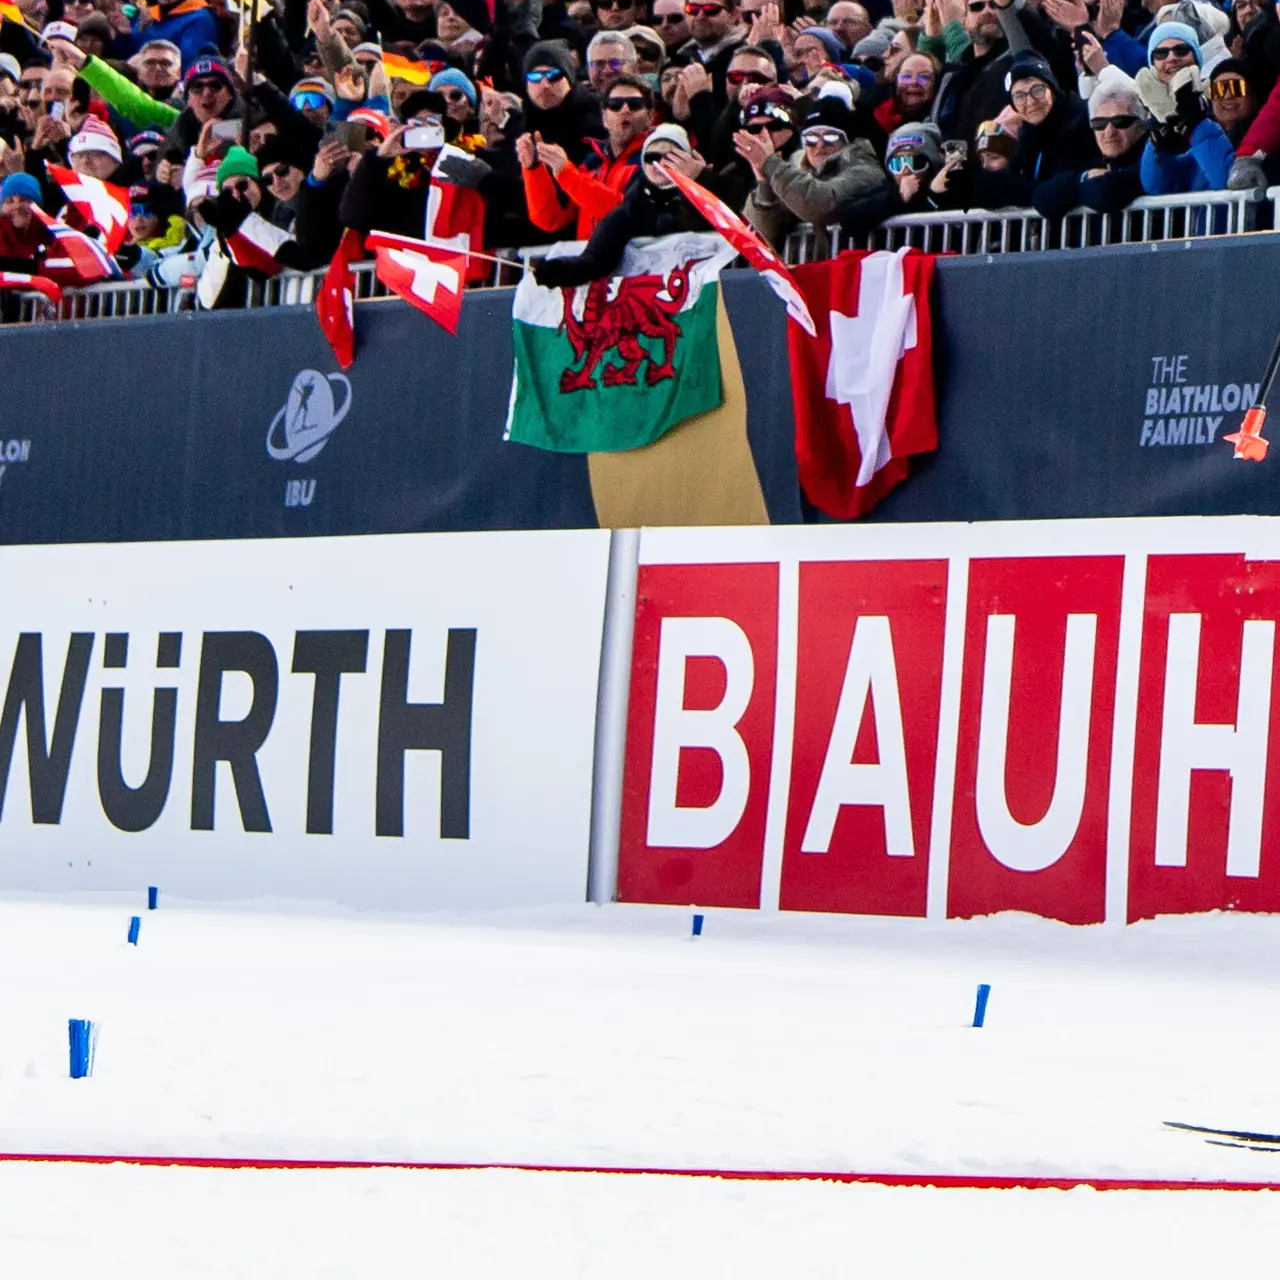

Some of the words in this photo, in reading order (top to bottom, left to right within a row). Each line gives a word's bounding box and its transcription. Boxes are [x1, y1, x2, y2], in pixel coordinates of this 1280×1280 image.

[1151, 355, 1189, 384] THE
[1144, 383, 1261, 416] BIATHLON
[1139, 416, 1224, 447] FAMILY
[284, 478, 317, 508] IBU
[0, 628, 478, 840] WÜRTH
